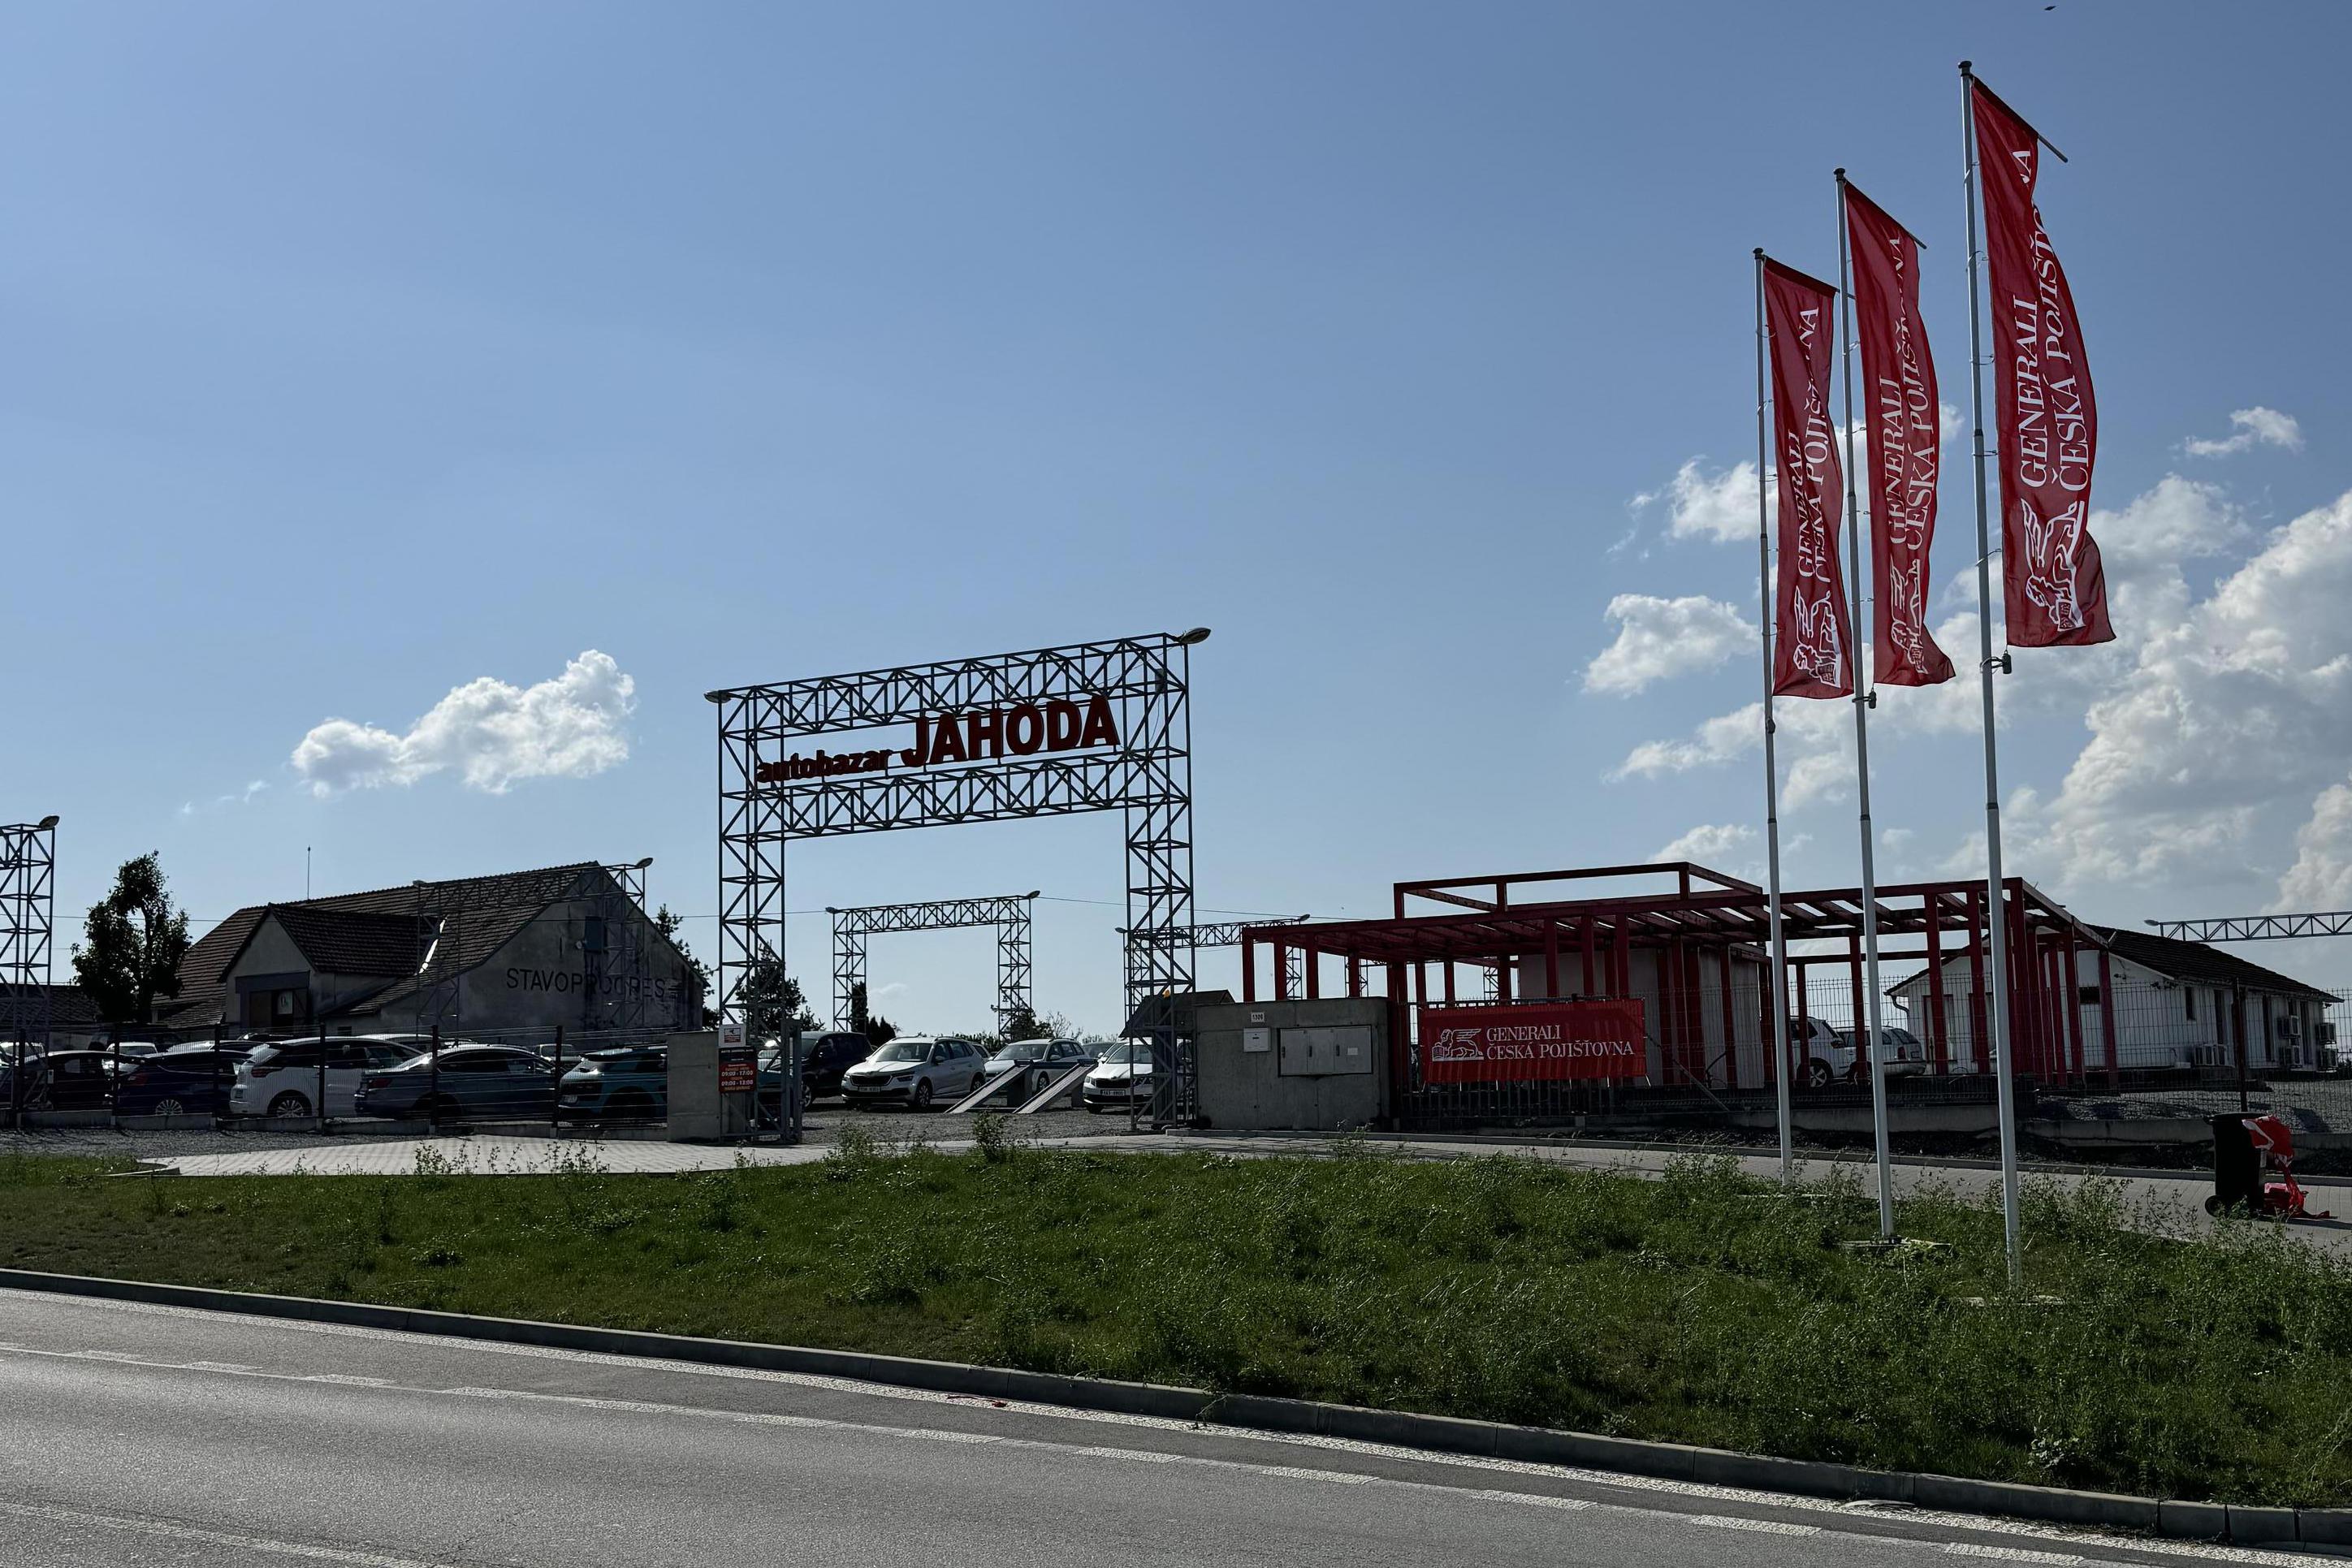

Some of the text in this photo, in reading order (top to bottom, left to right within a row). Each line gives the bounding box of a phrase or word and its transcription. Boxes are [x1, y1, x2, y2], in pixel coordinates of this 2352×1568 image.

[2013, 295, 2047, 488] GENERALI
[2043, 374, 2090, 492] ČESKÁ
[756, 694, 1120, 783] autobazar JAHODA
[1486, 1025, 1561, 1042] GENERALI
[1486, 1040, 1635, 1060] ČESKÁ POJIŠŤOVNA
